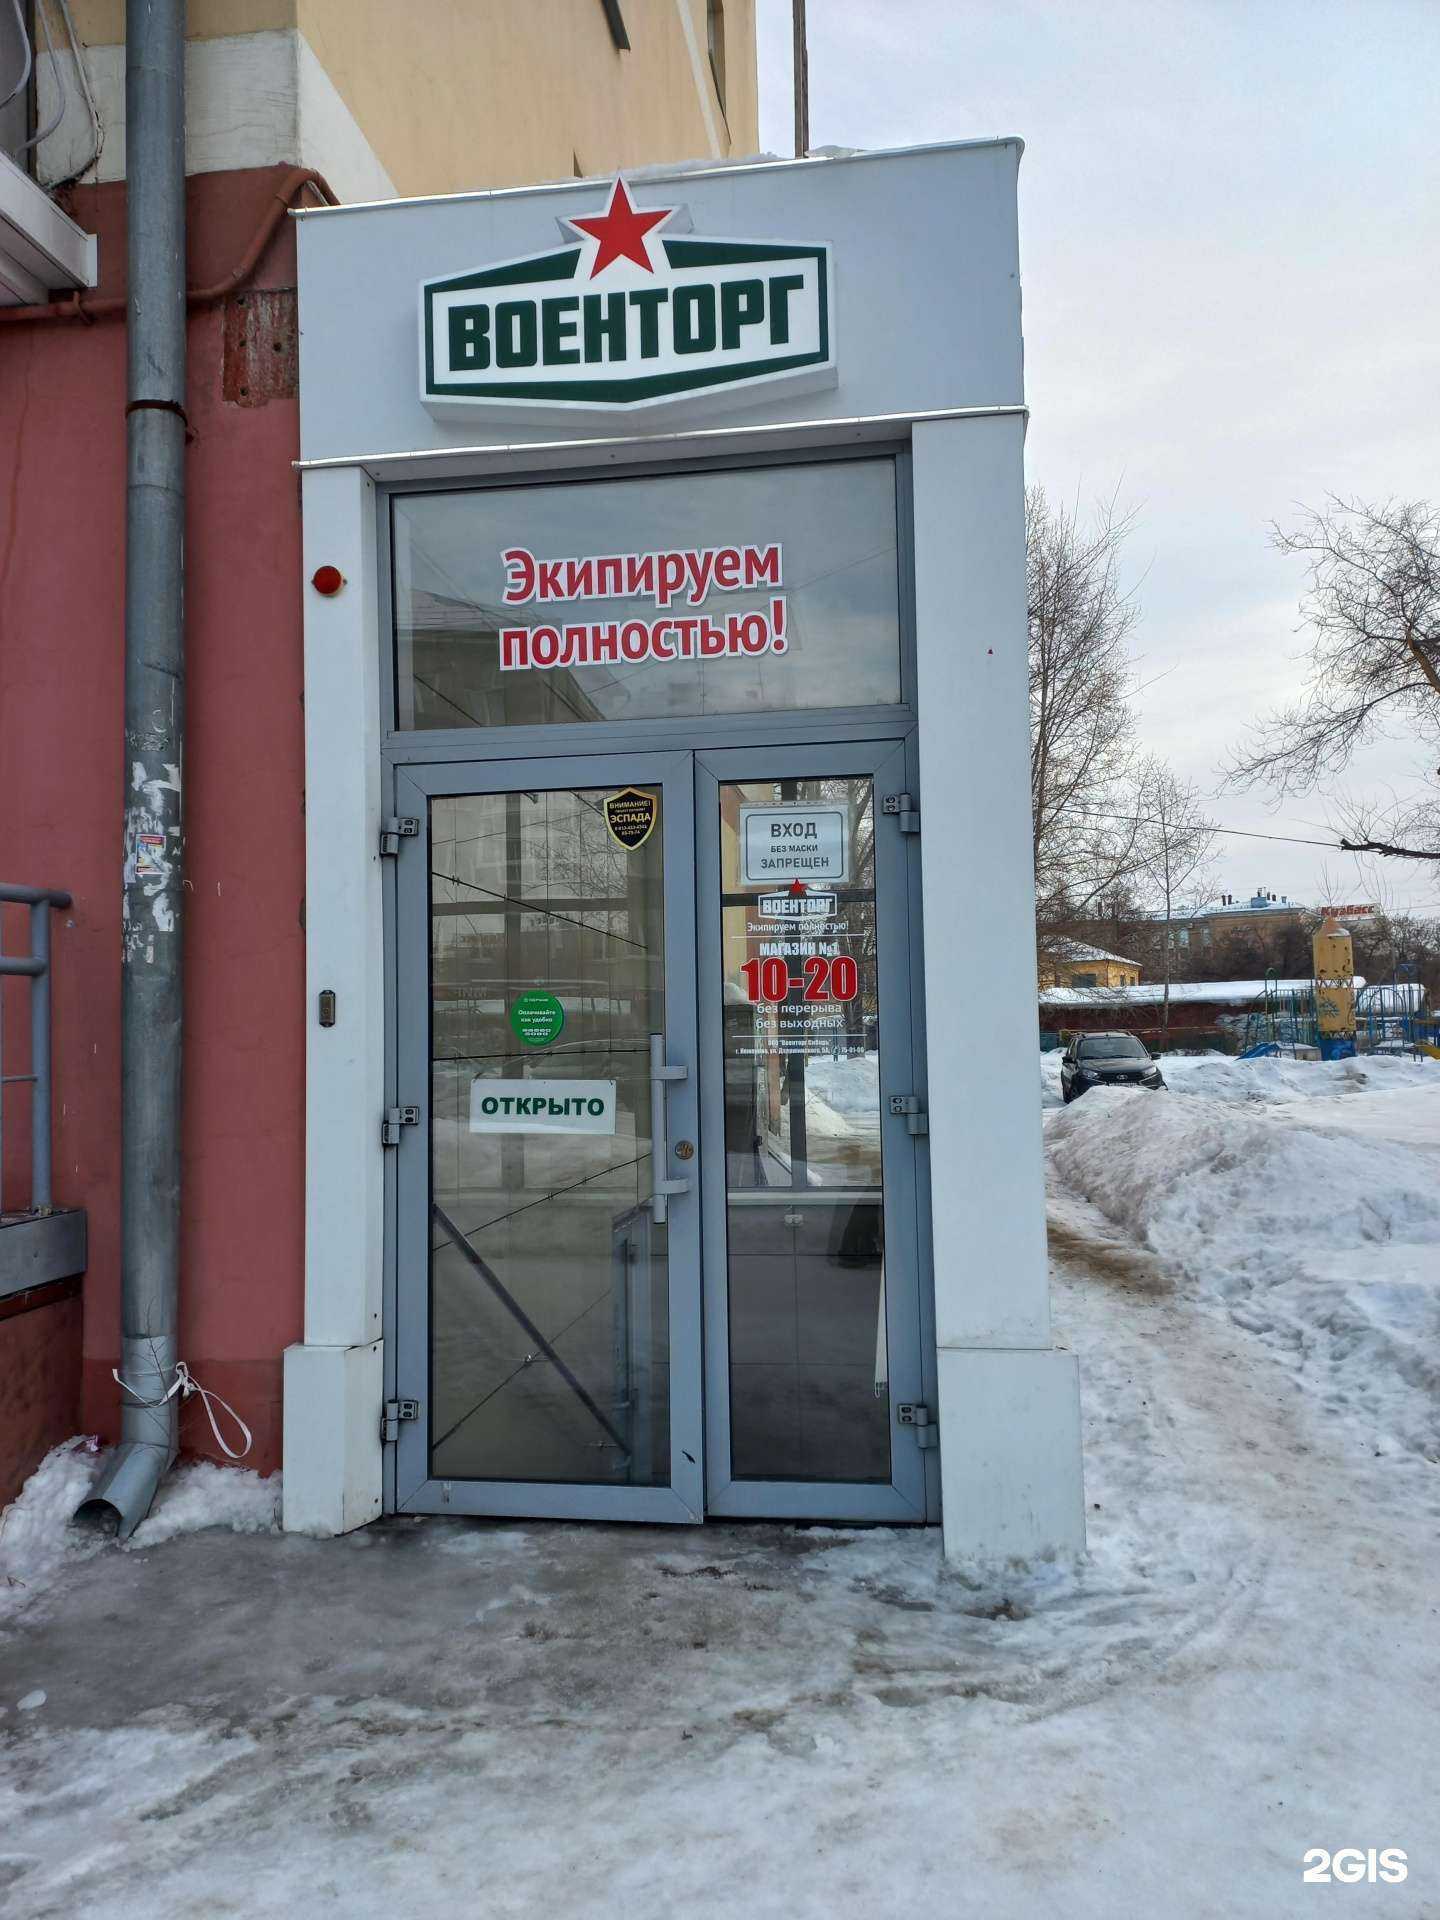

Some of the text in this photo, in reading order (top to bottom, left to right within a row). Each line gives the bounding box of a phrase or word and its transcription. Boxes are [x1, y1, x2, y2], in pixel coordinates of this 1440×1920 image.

[447, 273, 804, 372] ВОЕНТОРГ
[503, 545, 781, 607] Экипируем
[501, 599, 788, 669] полностью!
[609, 800, 651, 809] ВНИМАНИЕ!
[610, 813, 651, 824] ЭСПАДА
[770, 822, 818, 839] ВХОД
[770, 844, 818, 853] БЕЗ МАСКИ
[760, 856, 830, 869] ЗАПРЕЩЕН
[762, 898, 833, 914] ВОЕНТОРГ
[747, 922, 796, 934] Экипируем
[759, 942, 816, 956] МАГАЗИН
[740, 955, 858, 1002] 10-20
[756, 1003, 842, 1017] без перерыва
[755, 1018, 844, 1031] без выходных
[481, 1096, 605, 1116] ОТКРЫТО
